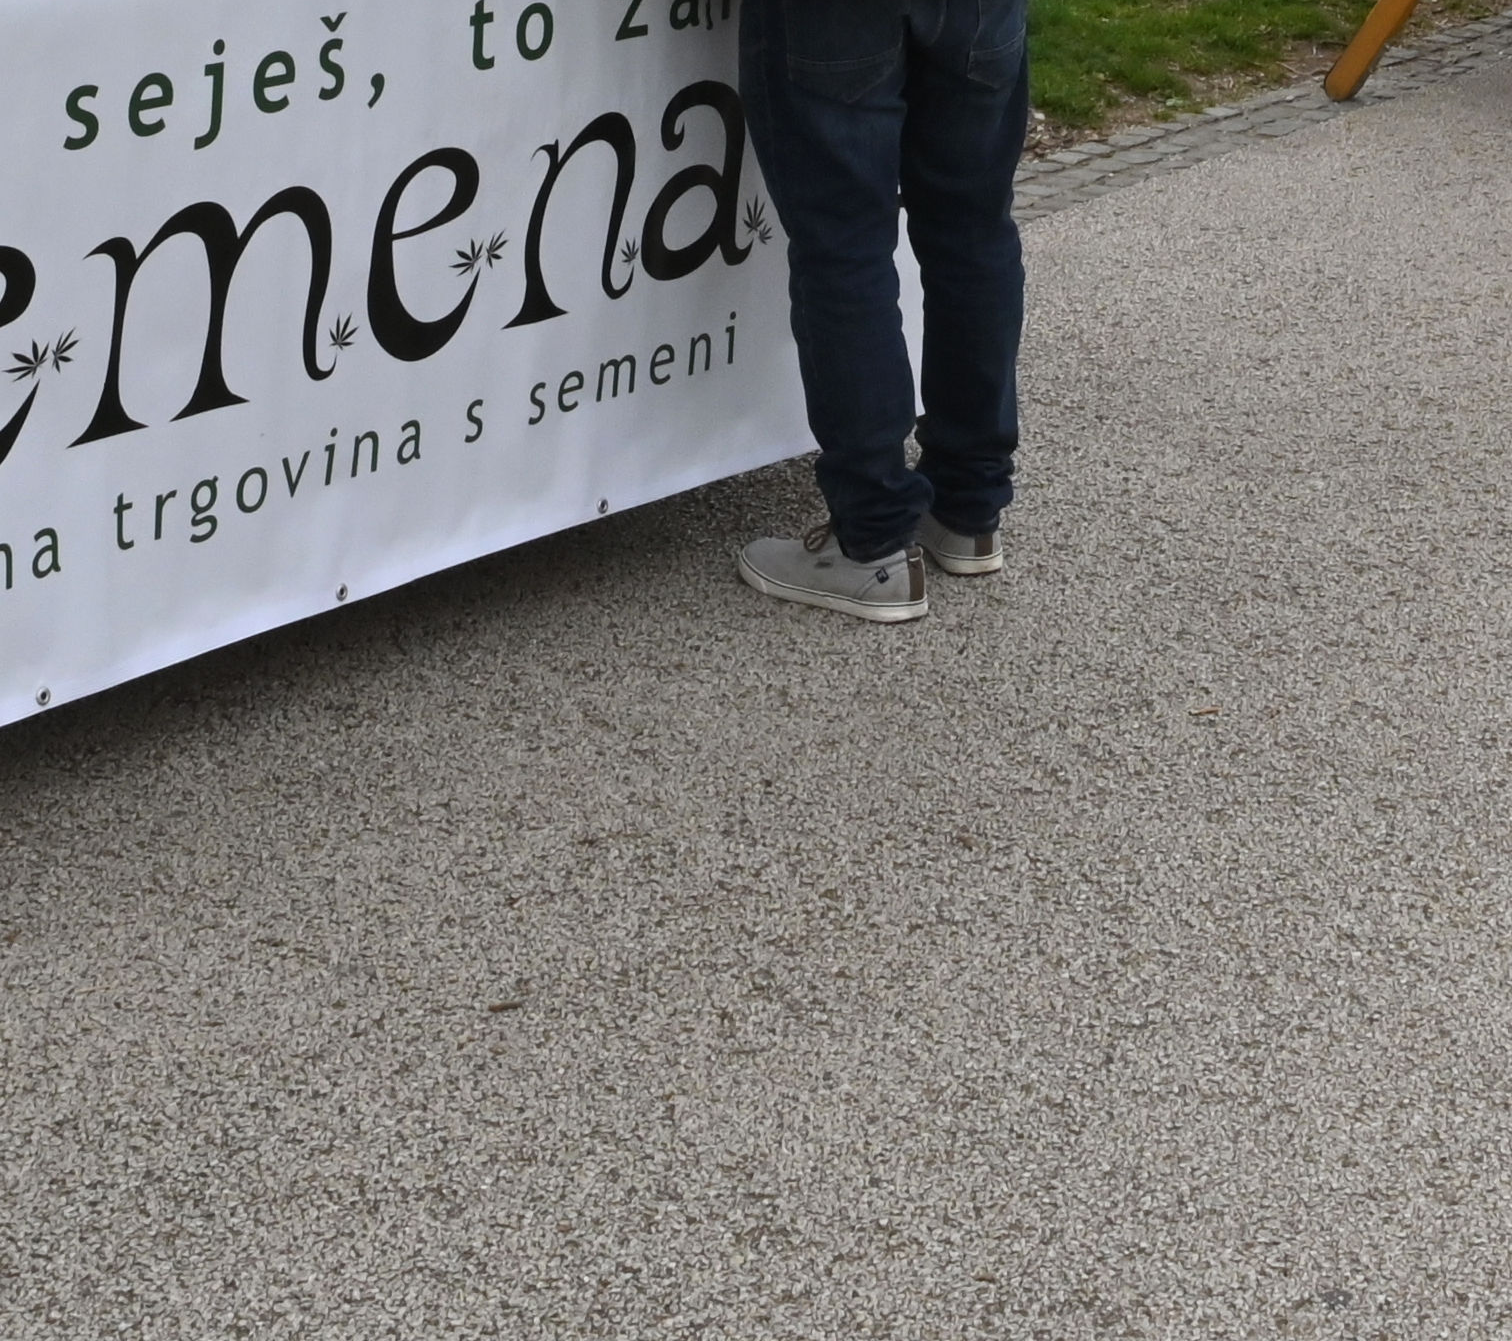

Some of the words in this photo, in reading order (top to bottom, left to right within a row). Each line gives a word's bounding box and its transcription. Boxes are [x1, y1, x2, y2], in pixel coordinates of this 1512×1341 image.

[64, 11, 385, 151] seješ,
[113, 419, 422, 552] trgovina
[464, 398, 484, 444] s
[528, 311, 738, 427] semeni
